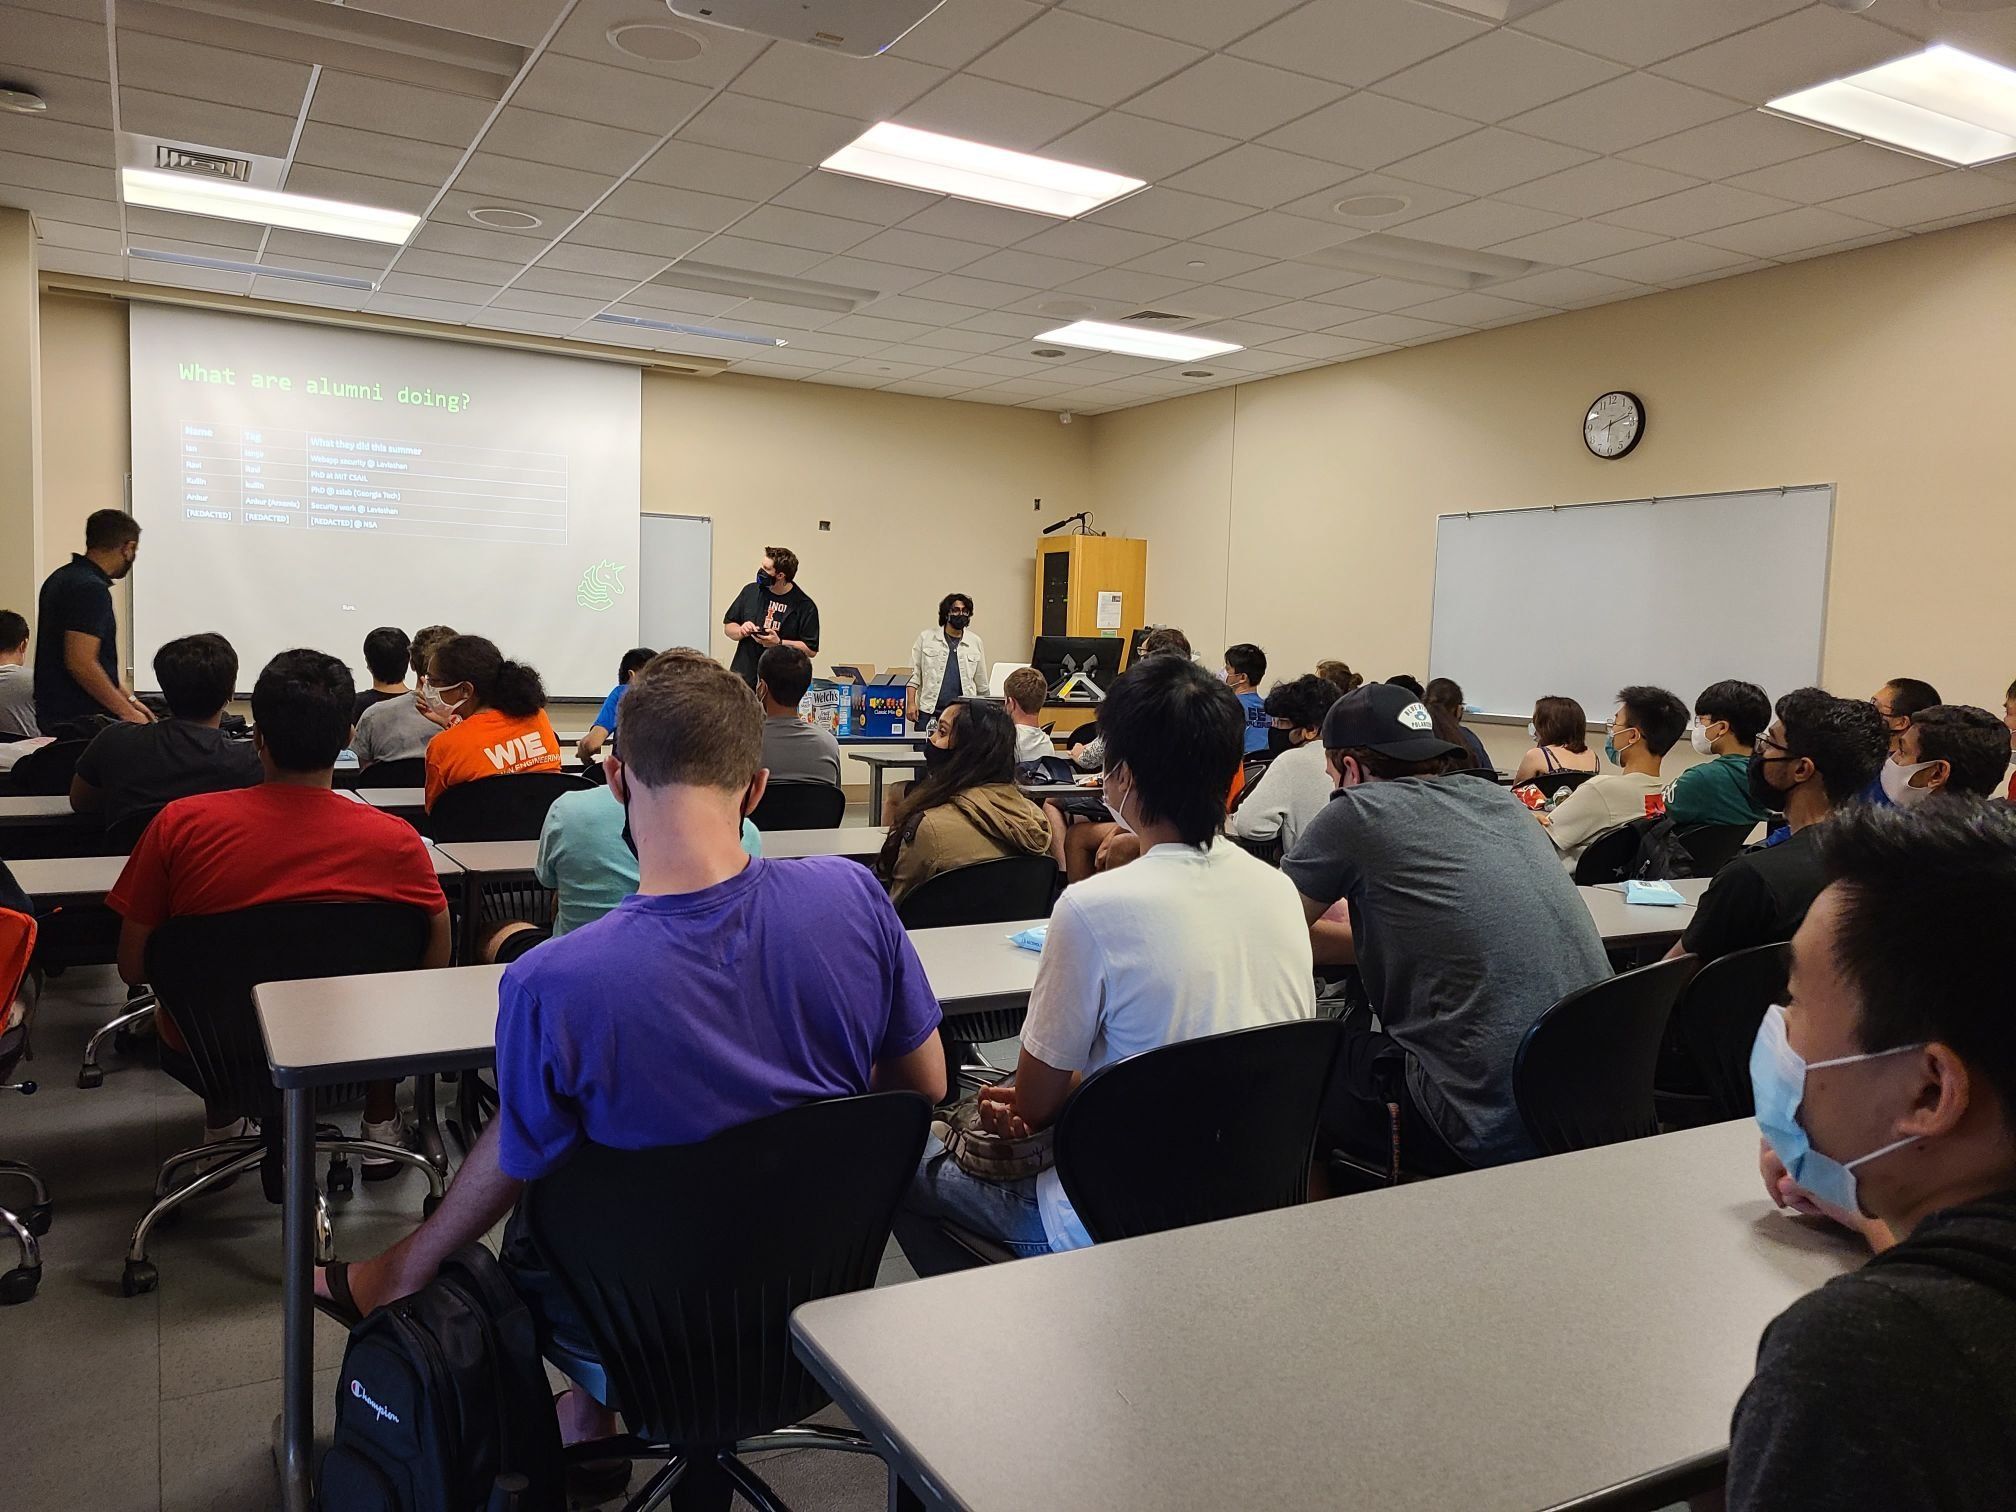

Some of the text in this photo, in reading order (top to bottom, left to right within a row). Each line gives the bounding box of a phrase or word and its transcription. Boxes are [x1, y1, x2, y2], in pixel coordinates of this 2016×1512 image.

[178, 363, 471, 413] What are alumni doing?
[1600, 401, 1606, 410] 11
[1608, 395, 1617, 405] 12
[1627, 406, 1633, 415] 2
[185, 425, 214, 438] Name
[1587, 424, 1593, 433] 9
[185, 443, 198, 452] Ian
[310, 437, 422, 456] What they did this summer
[340, 458, 366, 468] security
[367, 459, 375, 468] @
[310, 471, 325, 479] PhD
[326, 472, 333, 480] at
[334, 472, 347, 481] MIT
[310, 486, 325, 494] PhD
[326, 487, 335, 496] @
[353, 489, 382, 500] (Georgia
[311, 502, 338, 512] Security
[339, 504, 356, 513] work
[357, 505, 366, 514] @
[186, 508, 232, 521] [REDACTED]
[245, 511, 290, 525] [REDACTED]
[311, 517, 378, 529] [REDACTED] @ NSA
[813, 690, 838, 703] Welch's
[483, 731, 548, 770] WIE
[351, 1379, 399, 1423] Champion
